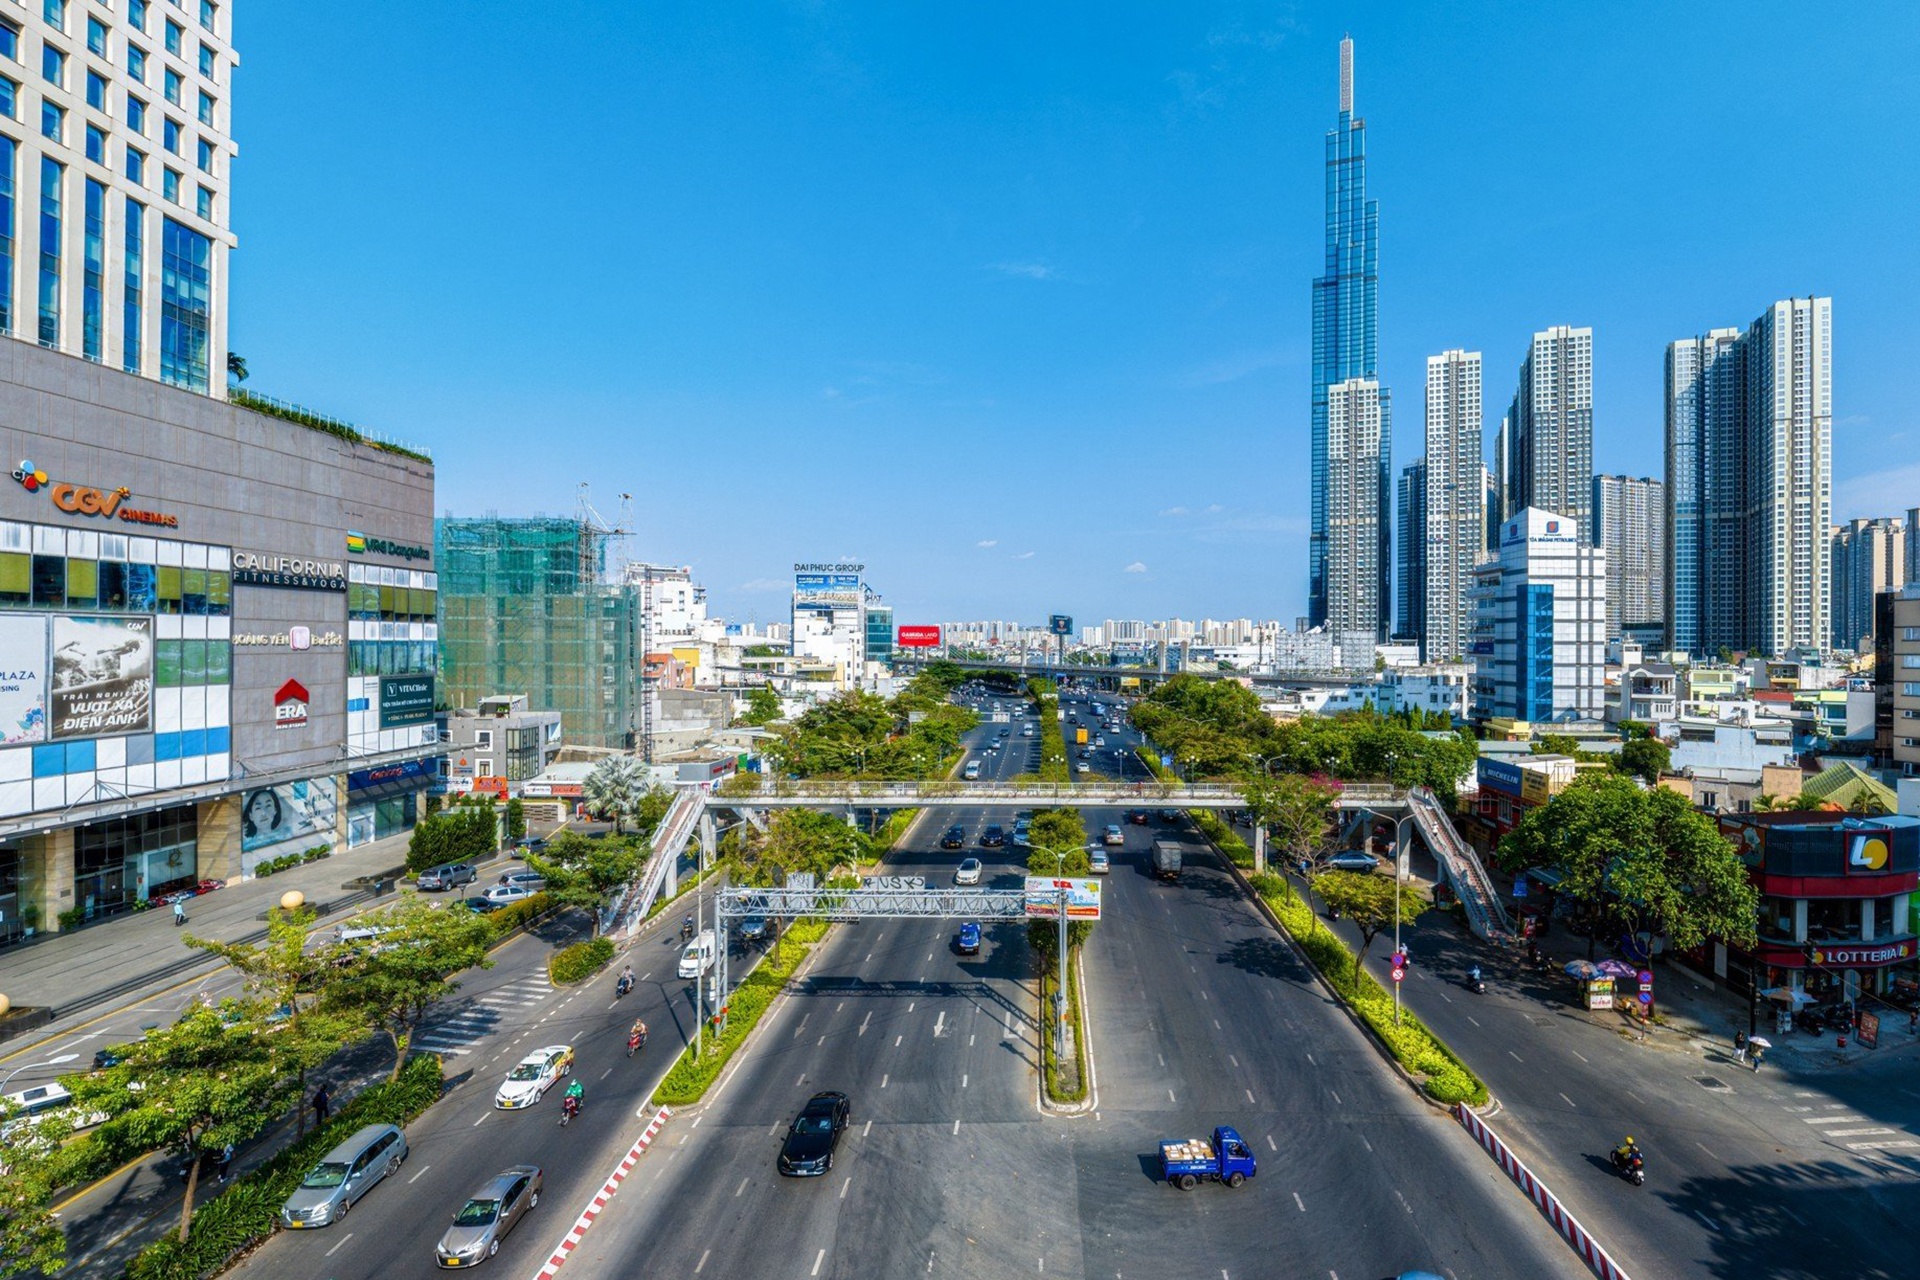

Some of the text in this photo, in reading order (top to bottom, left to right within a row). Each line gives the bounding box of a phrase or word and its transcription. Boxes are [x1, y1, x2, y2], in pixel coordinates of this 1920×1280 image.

[52, 483, 121, 516] CGV
[118, 507, 178, 526] CINEMAS
[233, 553, 344, 577] CALIFORNIA
[835, 564, 865, 572] GROUP
[233, 571, 346, 589] FITNESS&YOGA
[127, 622, 147, 631] CGV
[0, 685, 20, 693] SING
[276, 704, 307, 720] ERA
[63, 717, 101, 730] ĐIỆN
[1487, 768, 1519, 784] MICHELIN
[1828, 949, 1897, 963] LOTTERIA
